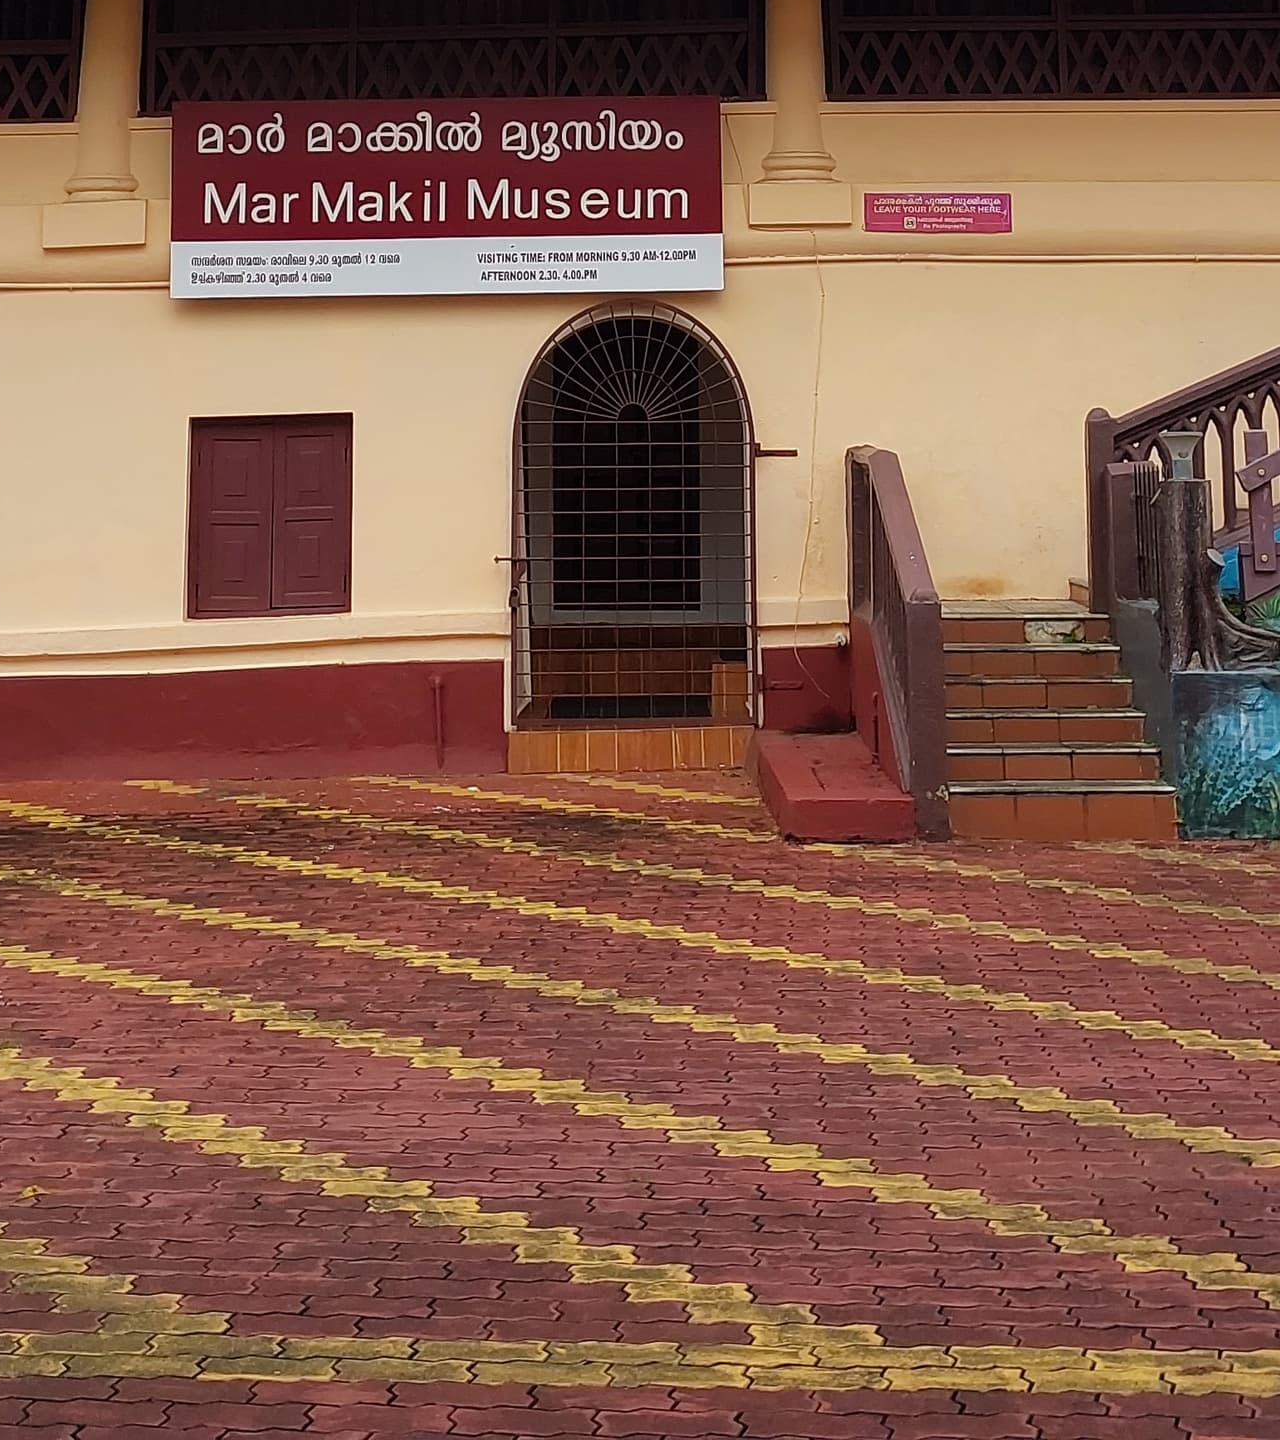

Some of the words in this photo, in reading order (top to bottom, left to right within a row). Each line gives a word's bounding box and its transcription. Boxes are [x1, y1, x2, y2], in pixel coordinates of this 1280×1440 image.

[197, 112, 286, 155] മാർ
[501, 109, 684, 163] മ്യൂസിയം
[203, 181, 299, 225] Mar
[311, 178, 446, 224] Makil
[467, 177, 689, 221] Museum
[365, 254, 376, 263] 12
[477, 253, 518, 263] VISITING
[548, 252, 573, 262] FROM
[576, 252, 618, 262] MORNING
[622, 252, 640, 261] 9.30
[247, 273, 266, 283] 2.30
[302, 273, 307, 282] 4
[481, 271, 536, 280] AFTERNOON
